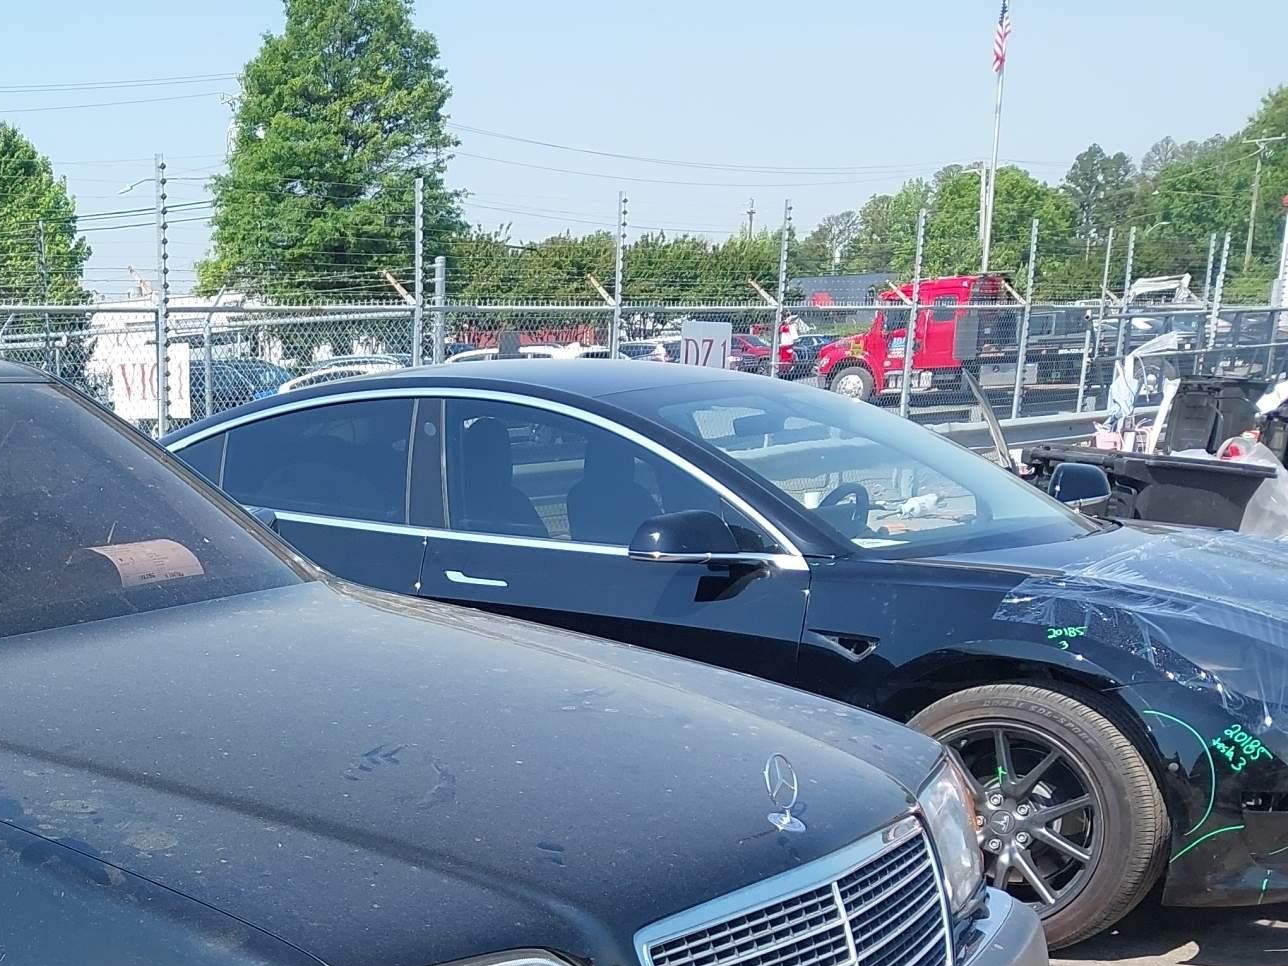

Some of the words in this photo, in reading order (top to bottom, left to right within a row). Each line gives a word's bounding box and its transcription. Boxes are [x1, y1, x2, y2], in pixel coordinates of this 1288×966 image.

[1058, 640, 1069, 650] 3
[1223, 723, 1273, 760] 20185
[1230, 756, 1247, 771] 3
